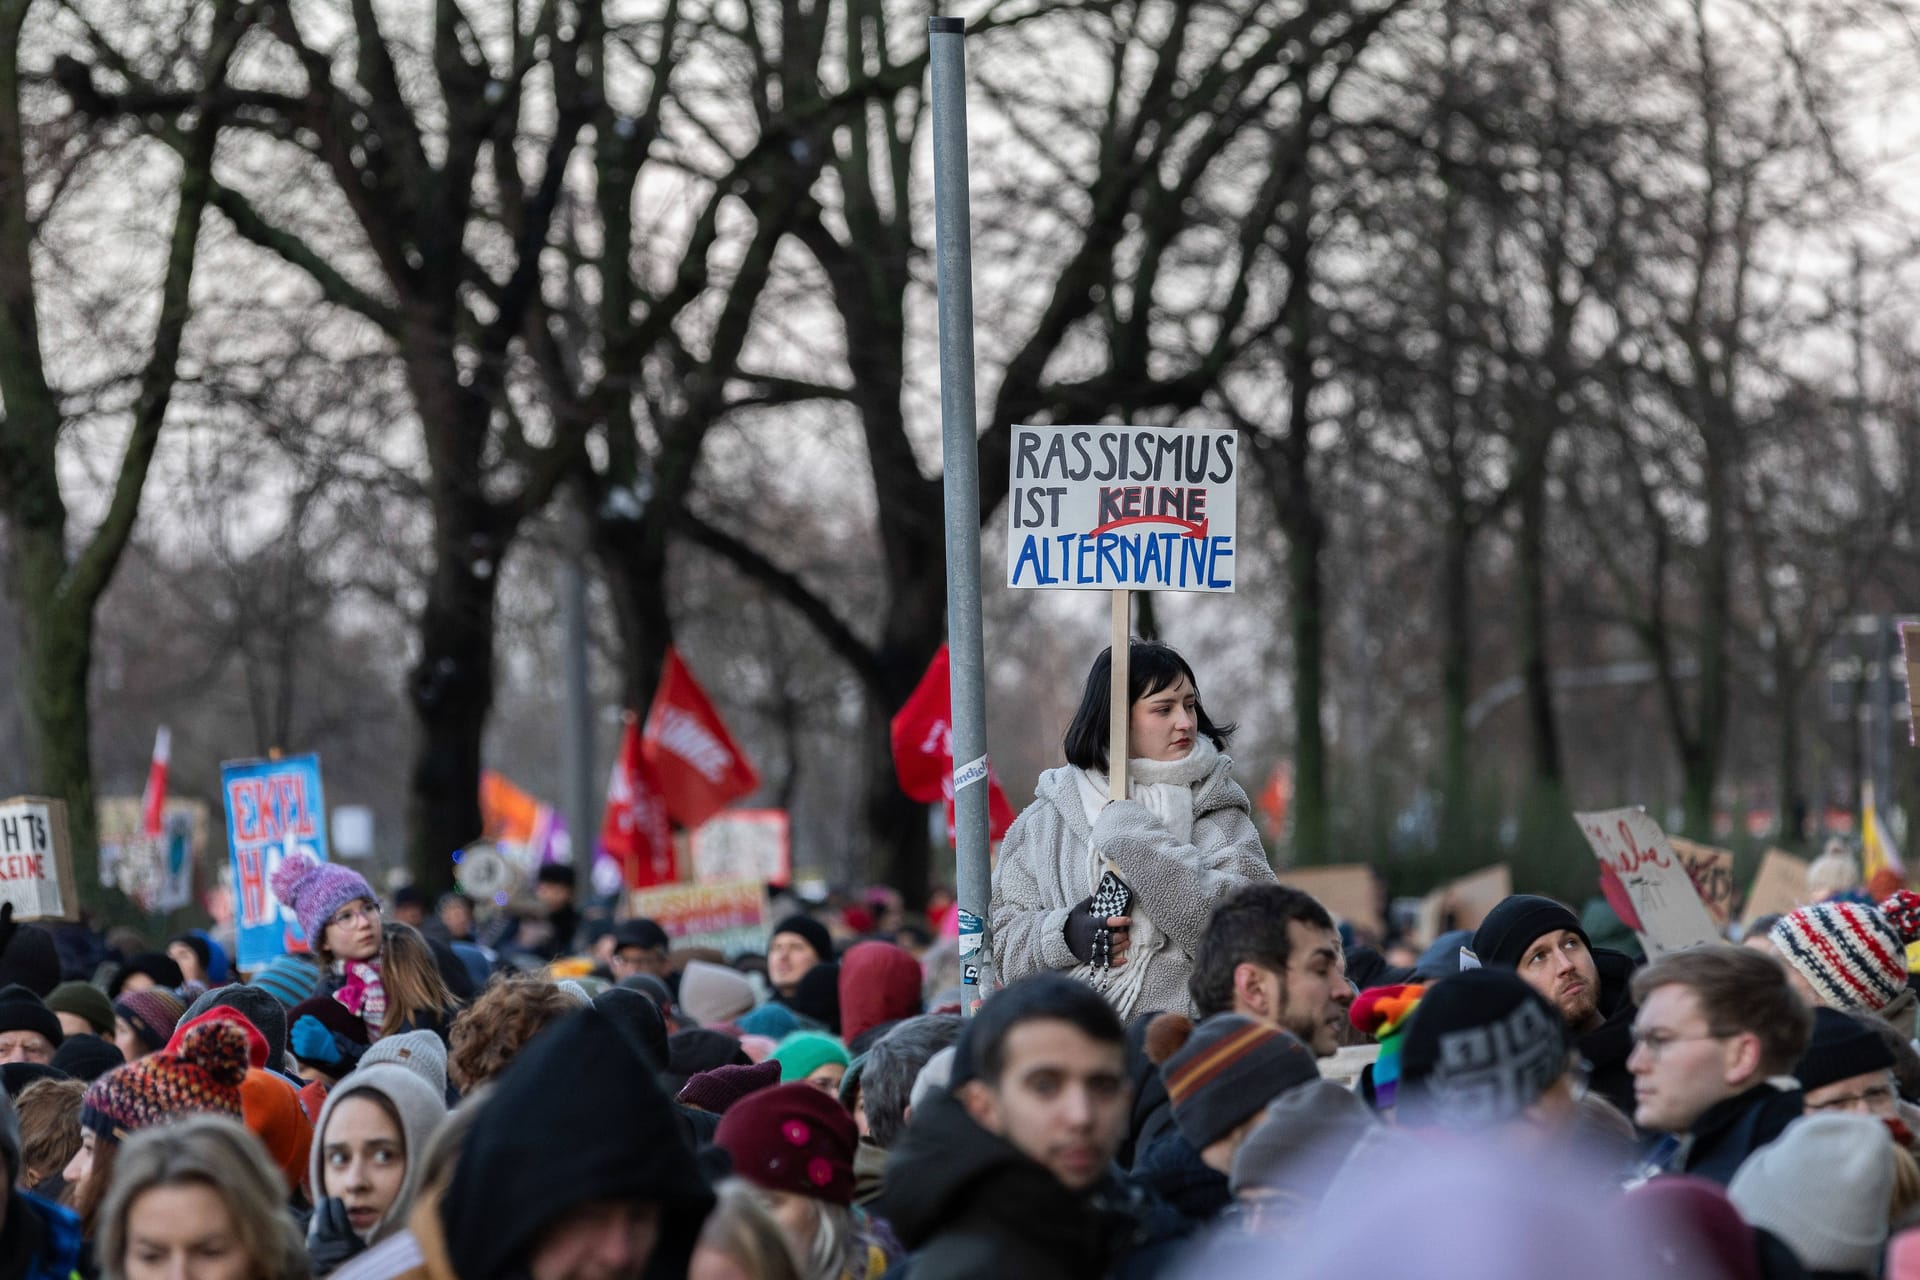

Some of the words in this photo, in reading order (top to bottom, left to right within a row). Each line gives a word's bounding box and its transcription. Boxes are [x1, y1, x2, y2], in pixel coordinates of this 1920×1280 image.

[1016, 432, 1234, 484] RASSISMUS
[1013, 486, 1067, 528] IST
[1098, 485, 1207, 525] KEINE
[1012, 532, 1233, 588] ALTERNATIVE
[229, 772, 315, 842] EKEL
